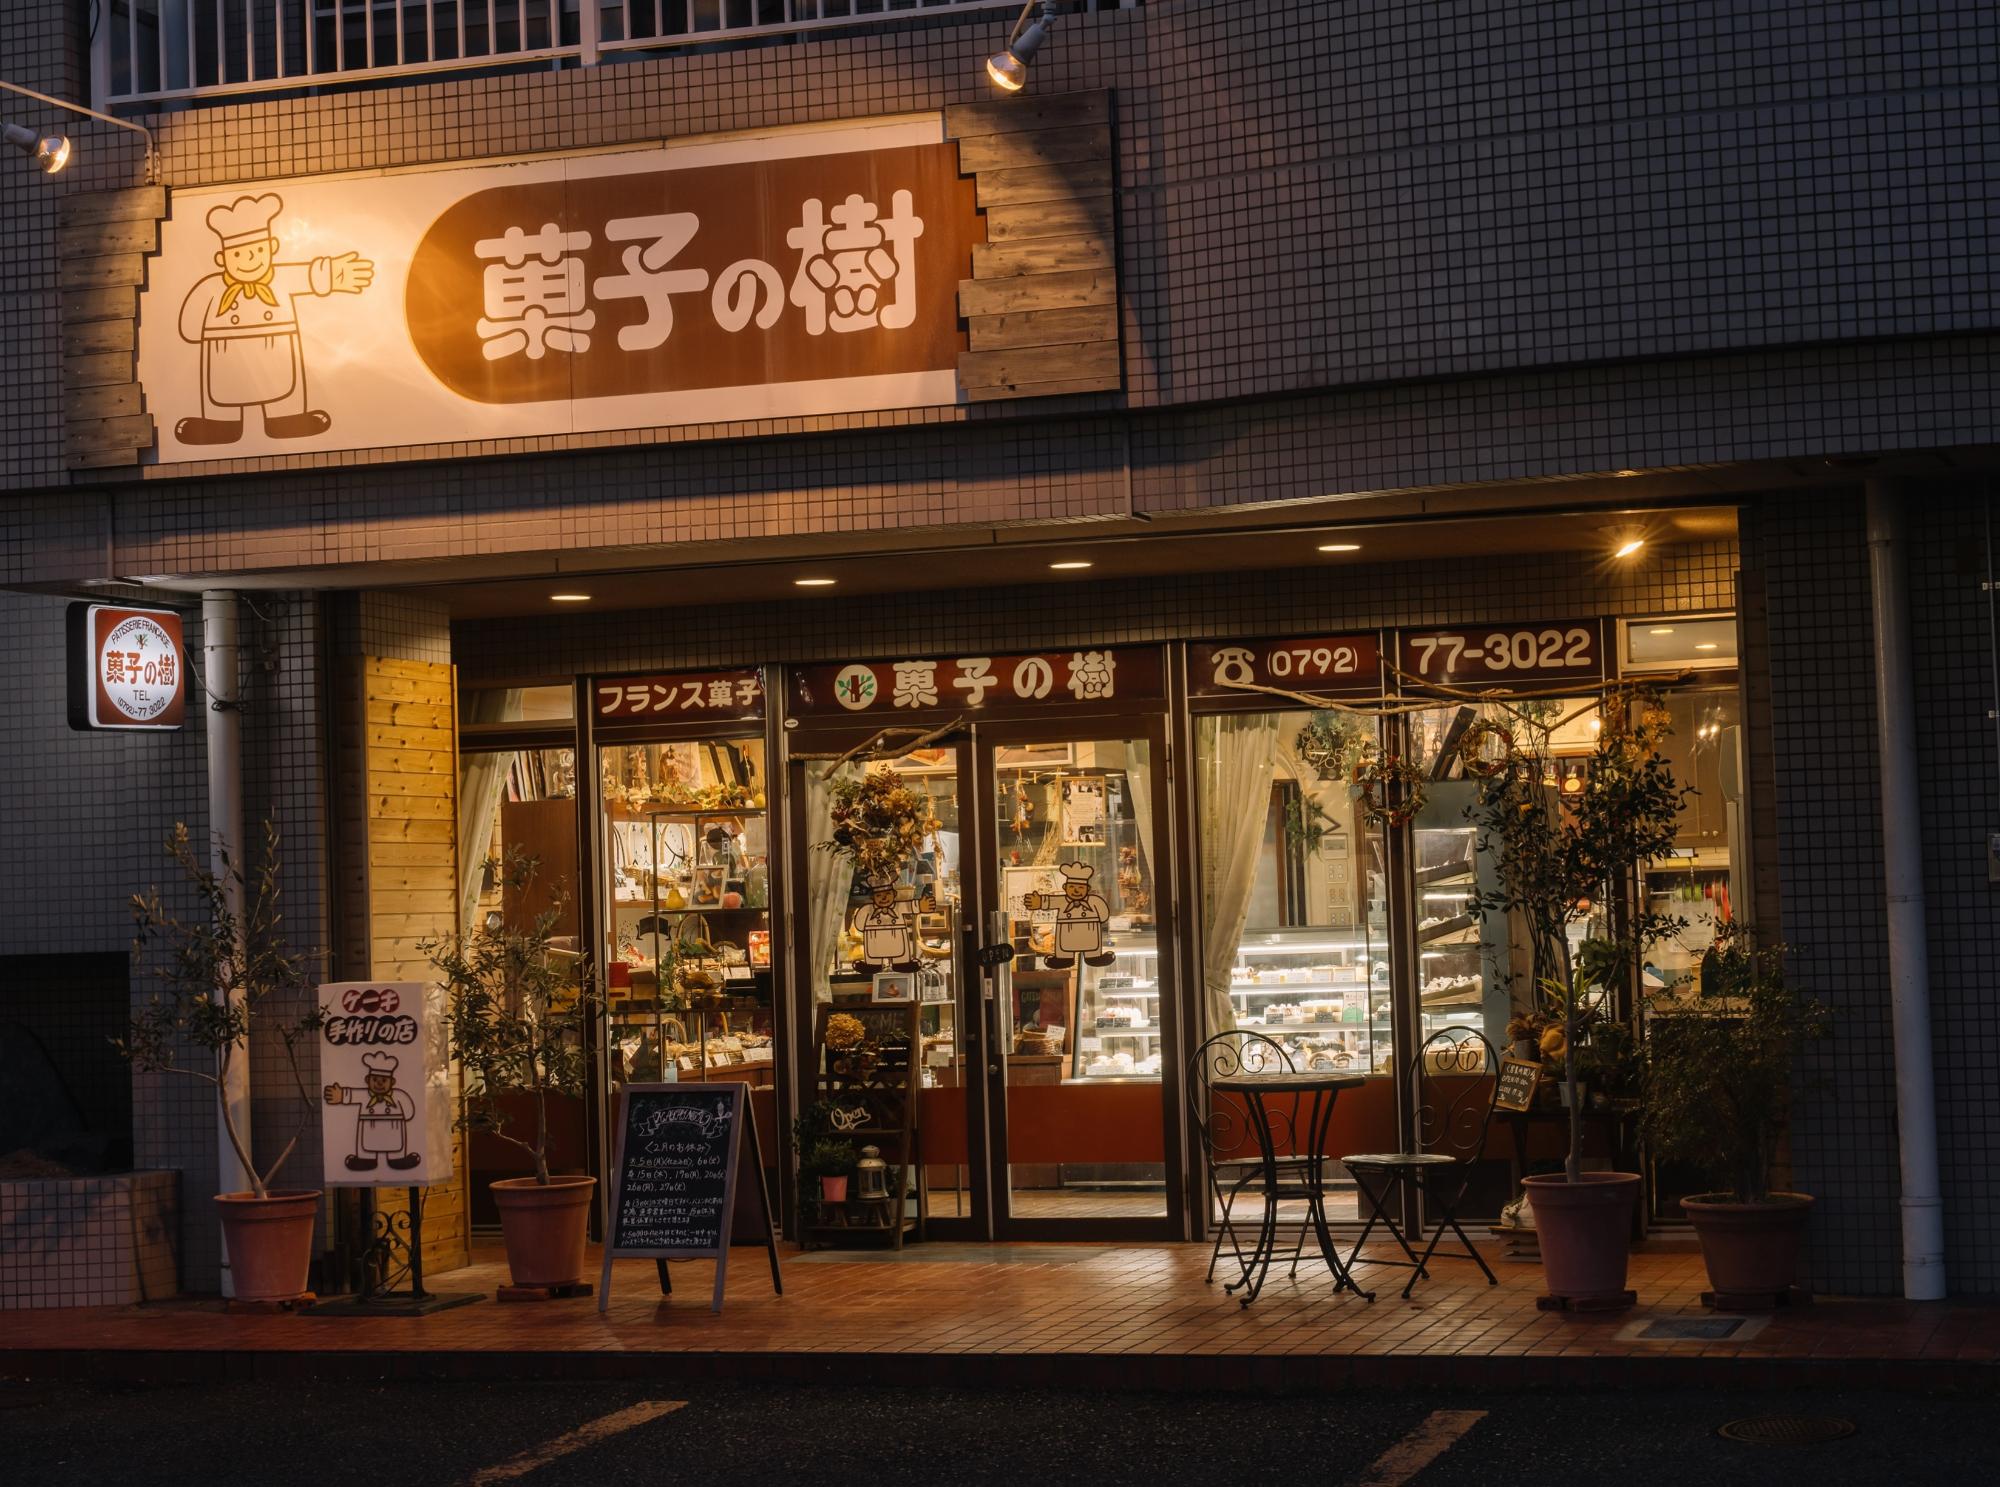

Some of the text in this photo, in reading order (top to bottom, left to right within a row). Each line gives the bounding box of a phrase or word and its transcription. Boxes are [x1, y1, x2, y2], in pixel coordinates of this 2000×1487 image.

[475, 189, 924, 360] 菓子の樹
[1267, 646, 1358, 676] (0792)
[1410, 628, 1591, 674] 77-3022
[106, 650, 175, 685] 菓子の樹
[892, 650, 1117, 708] 菓子の樹
[133, 690, 150, 701] TEL
[598, 678, 762, 713] フランス菓子
[343, 990, 398, 1012] ケーキ
[329, 1018, 415, 1042] 手作りの店
[831, 1107, 871, 1130] Open
